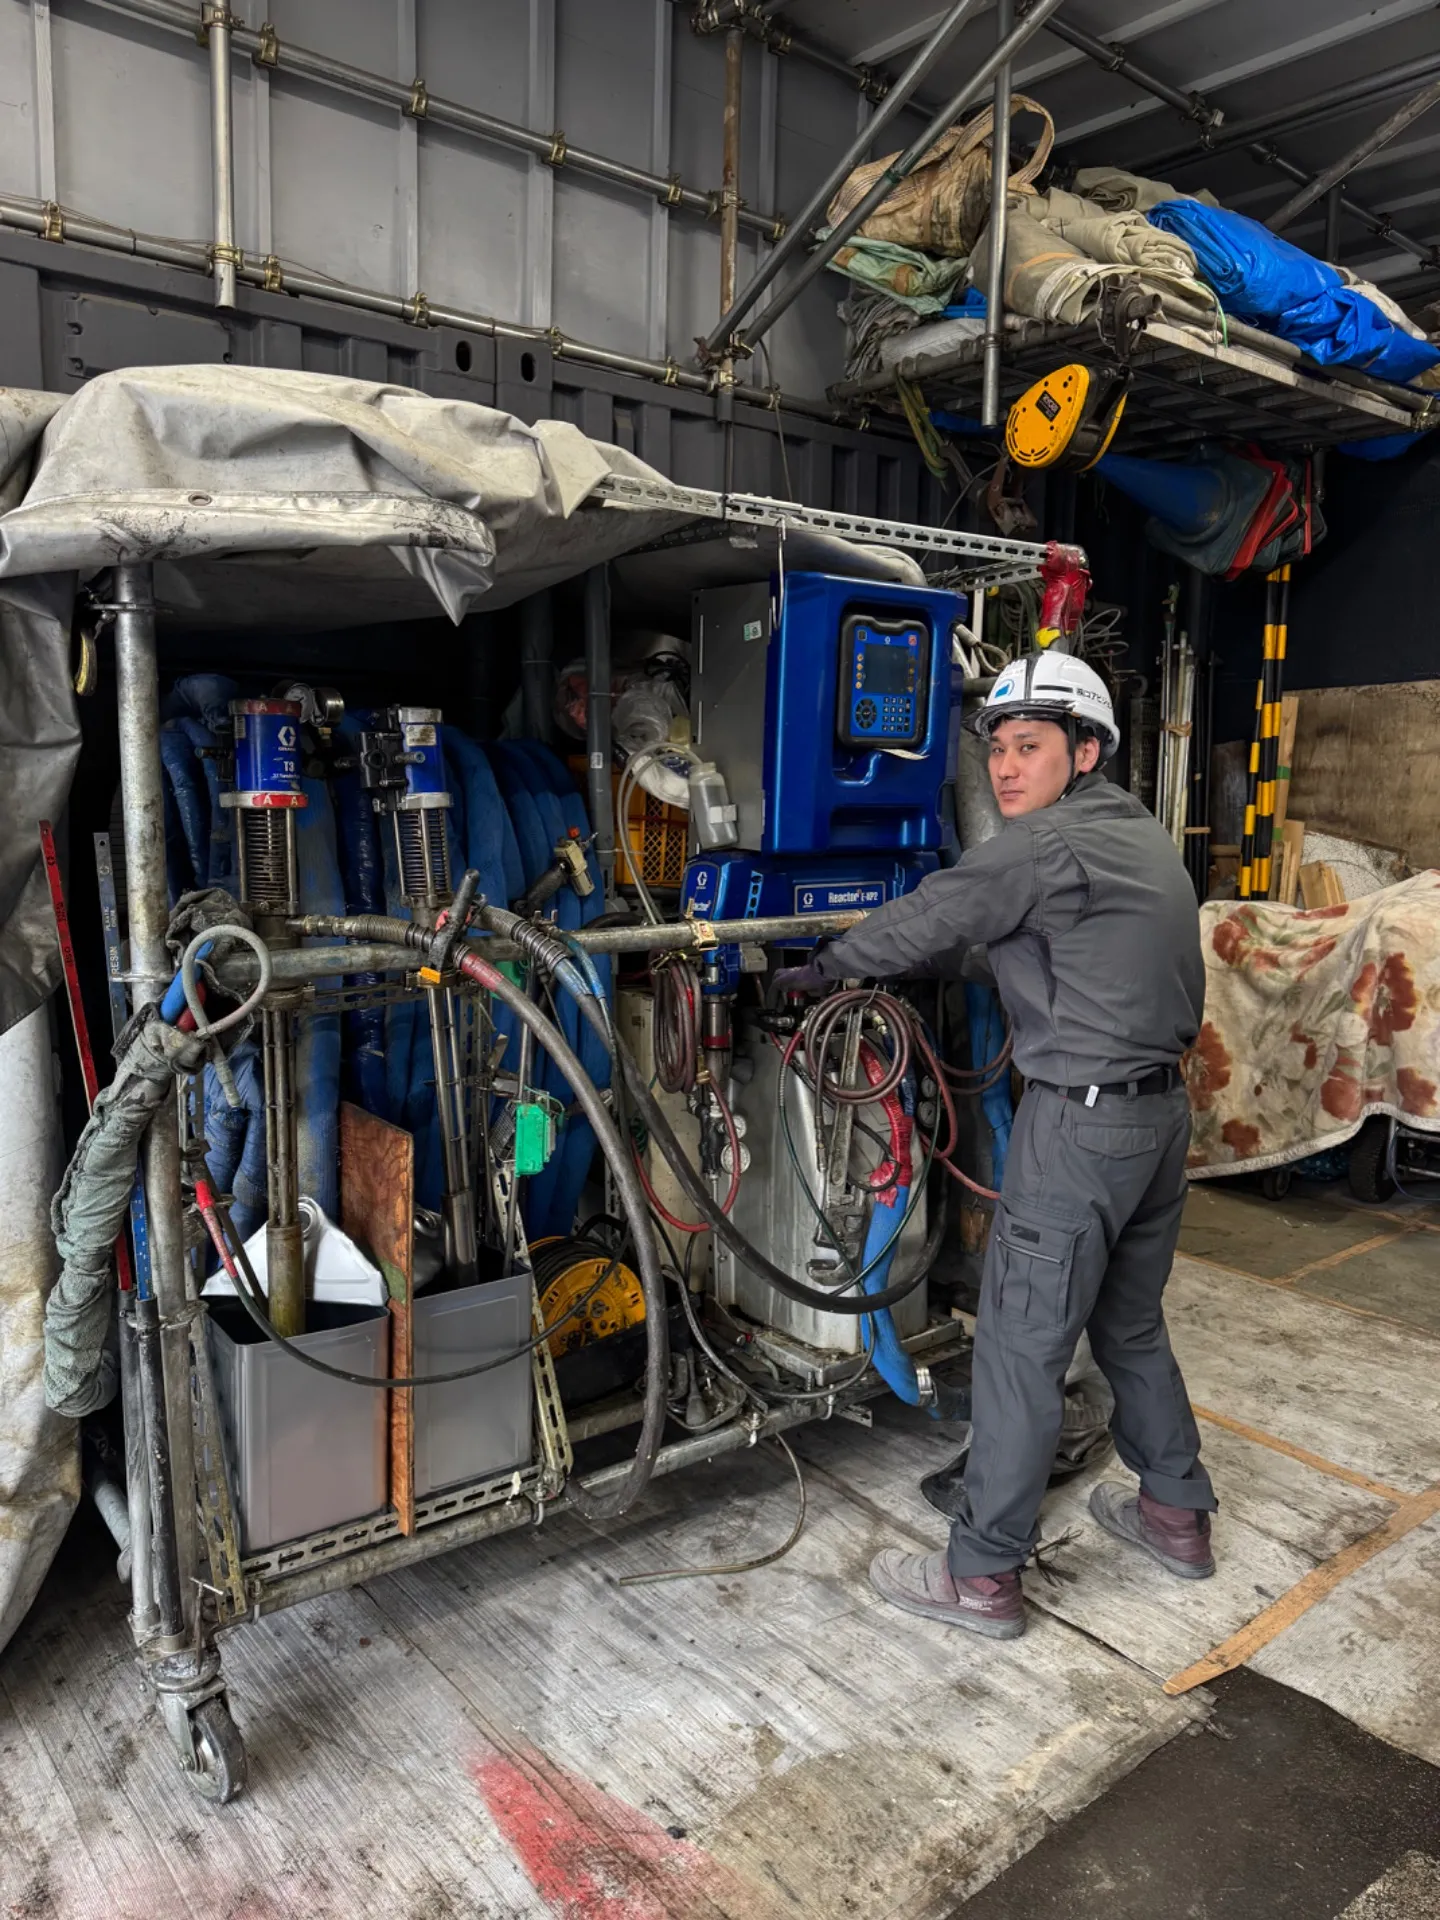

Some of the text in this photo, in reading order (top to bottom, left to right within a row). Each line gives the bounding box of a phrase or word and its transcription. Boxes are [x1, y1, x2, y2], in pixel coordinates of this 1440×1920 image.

[283, 760, 295, 772] T3
[263, 795, 298, 806] A A
[109, 945, 120, 975] RESIN
